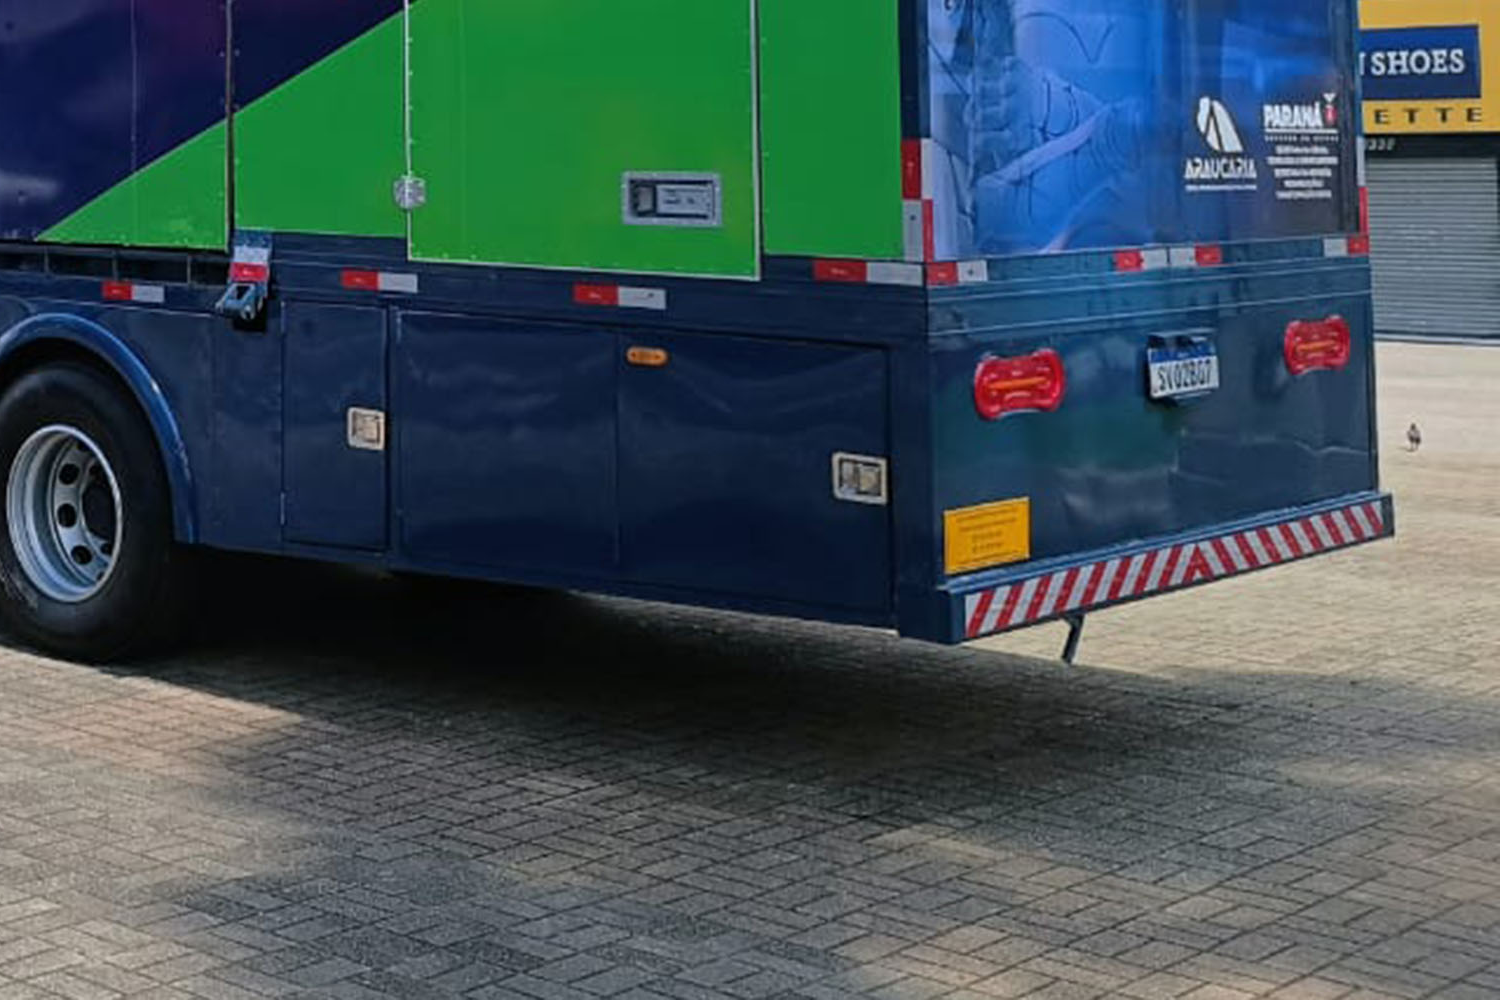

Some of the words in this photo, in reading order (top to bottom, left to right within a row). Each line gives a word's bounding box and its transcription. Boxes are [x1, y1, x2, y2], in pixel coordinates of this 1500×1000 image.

[1371, 49, 1466, 76] SHOES
[1263, 102, 1324, 128] PARANÁ
[1374, 106, 1483, 125] ETTE
